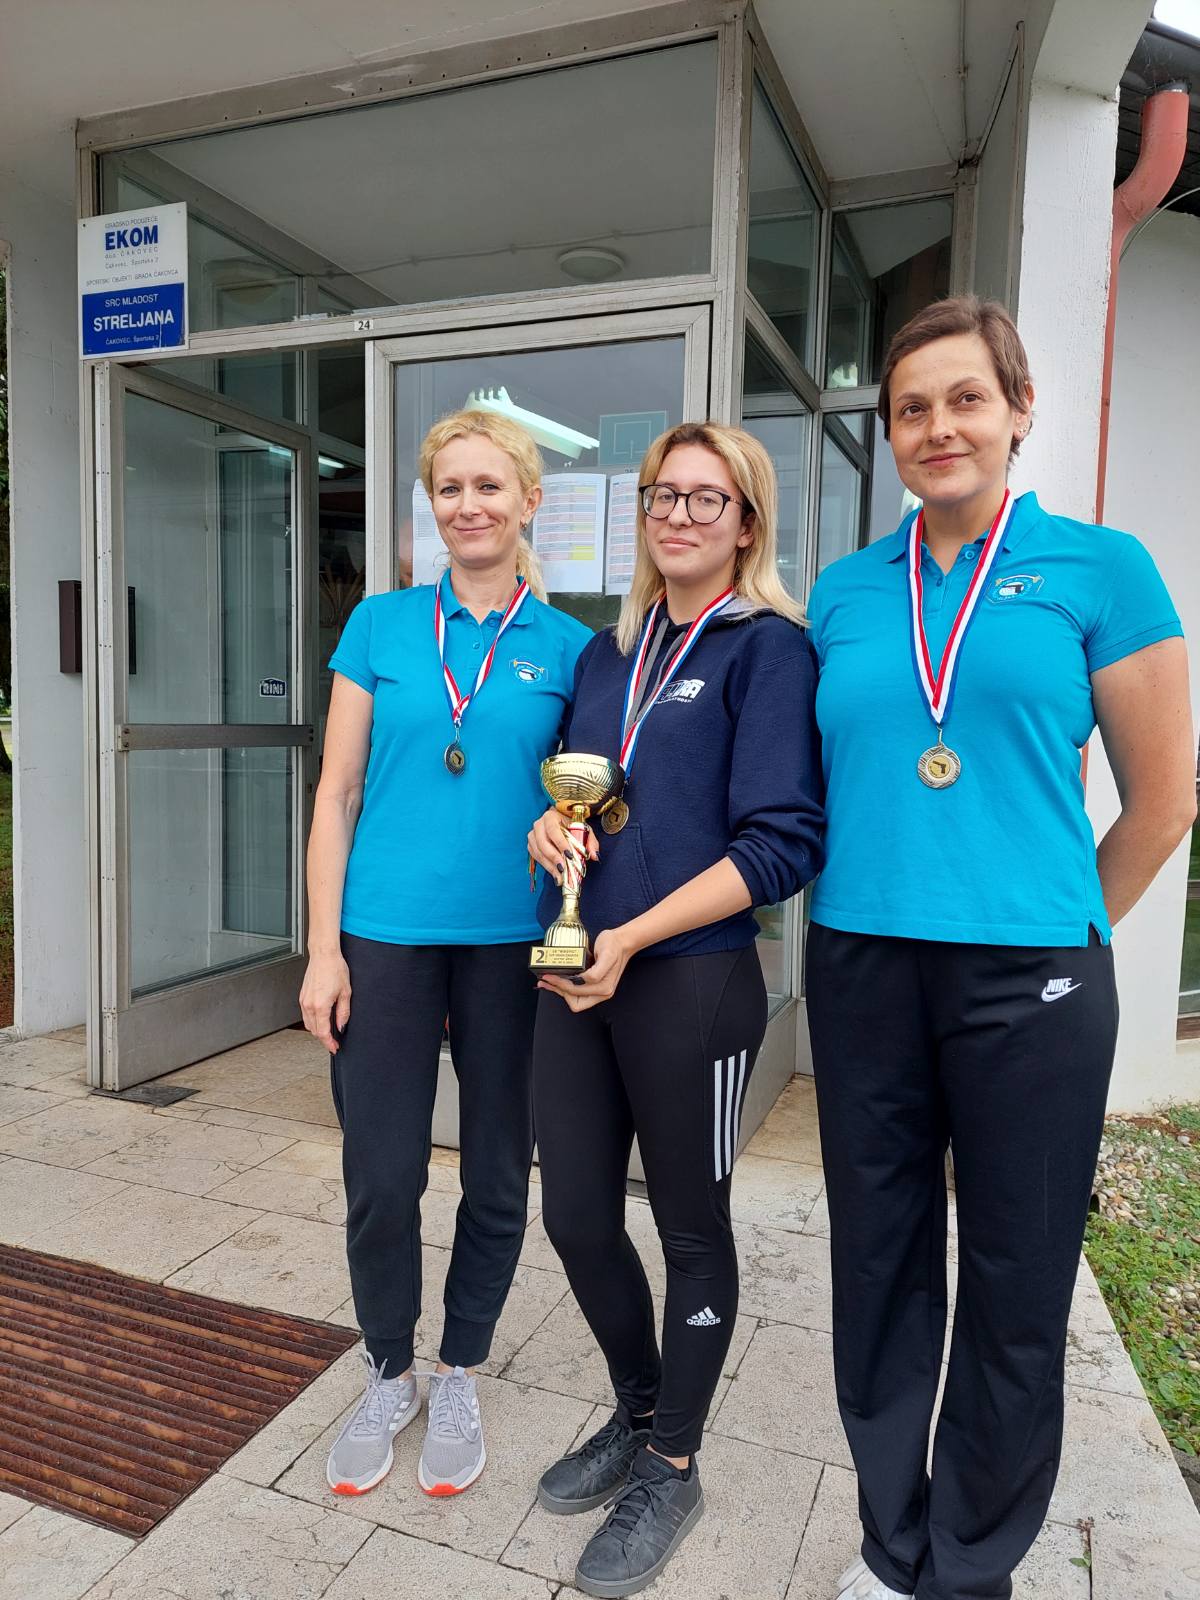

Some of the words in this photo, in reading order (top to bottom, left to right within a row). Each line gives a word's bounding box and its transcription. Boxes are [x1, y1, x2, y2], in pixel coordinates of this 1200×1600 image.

[105, 225, 158, 250] EKOM
[105, 298, 121, 308] SRC
[122, 293, 159, 306] MLADOST
[93, 309, 175, 332] STRELJANA
[358, 320, 370, 331] 24
[1046, 977, 1073, 993] NIKE
[686, 1317, 721, 1326] adidas
